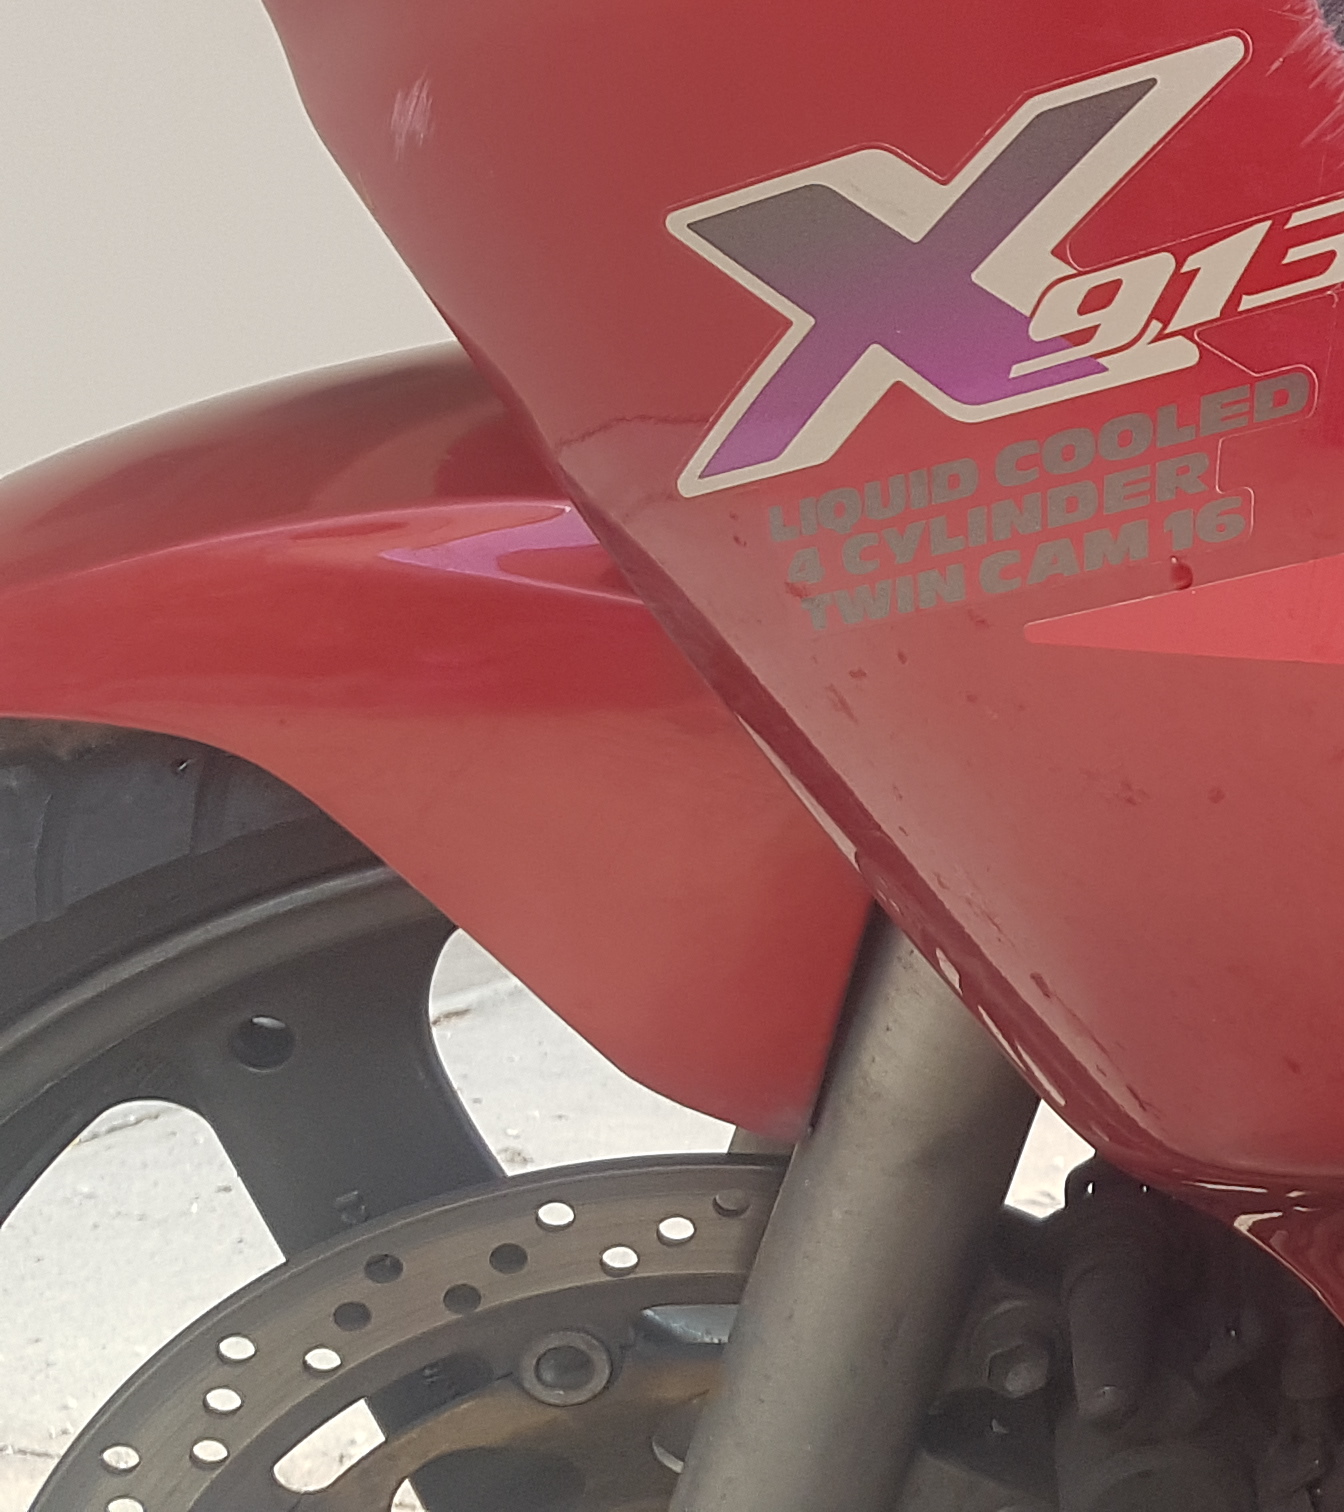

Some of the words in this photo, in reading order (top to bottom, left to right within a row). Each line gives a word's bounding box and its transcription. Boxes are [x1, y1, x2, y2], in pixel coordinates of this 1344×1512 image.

[768, 457, 979, 542] LIQUID
[994, 371, 1310, 487] COOLED
[786, 545, 826, 584] 4
[841, 451, 1210, 576] CYLINDER
[800, 562, 966, 631] TWIN
[978, 518, 1150, 595] CAM
[1163, 495, 1247, 552] 16
